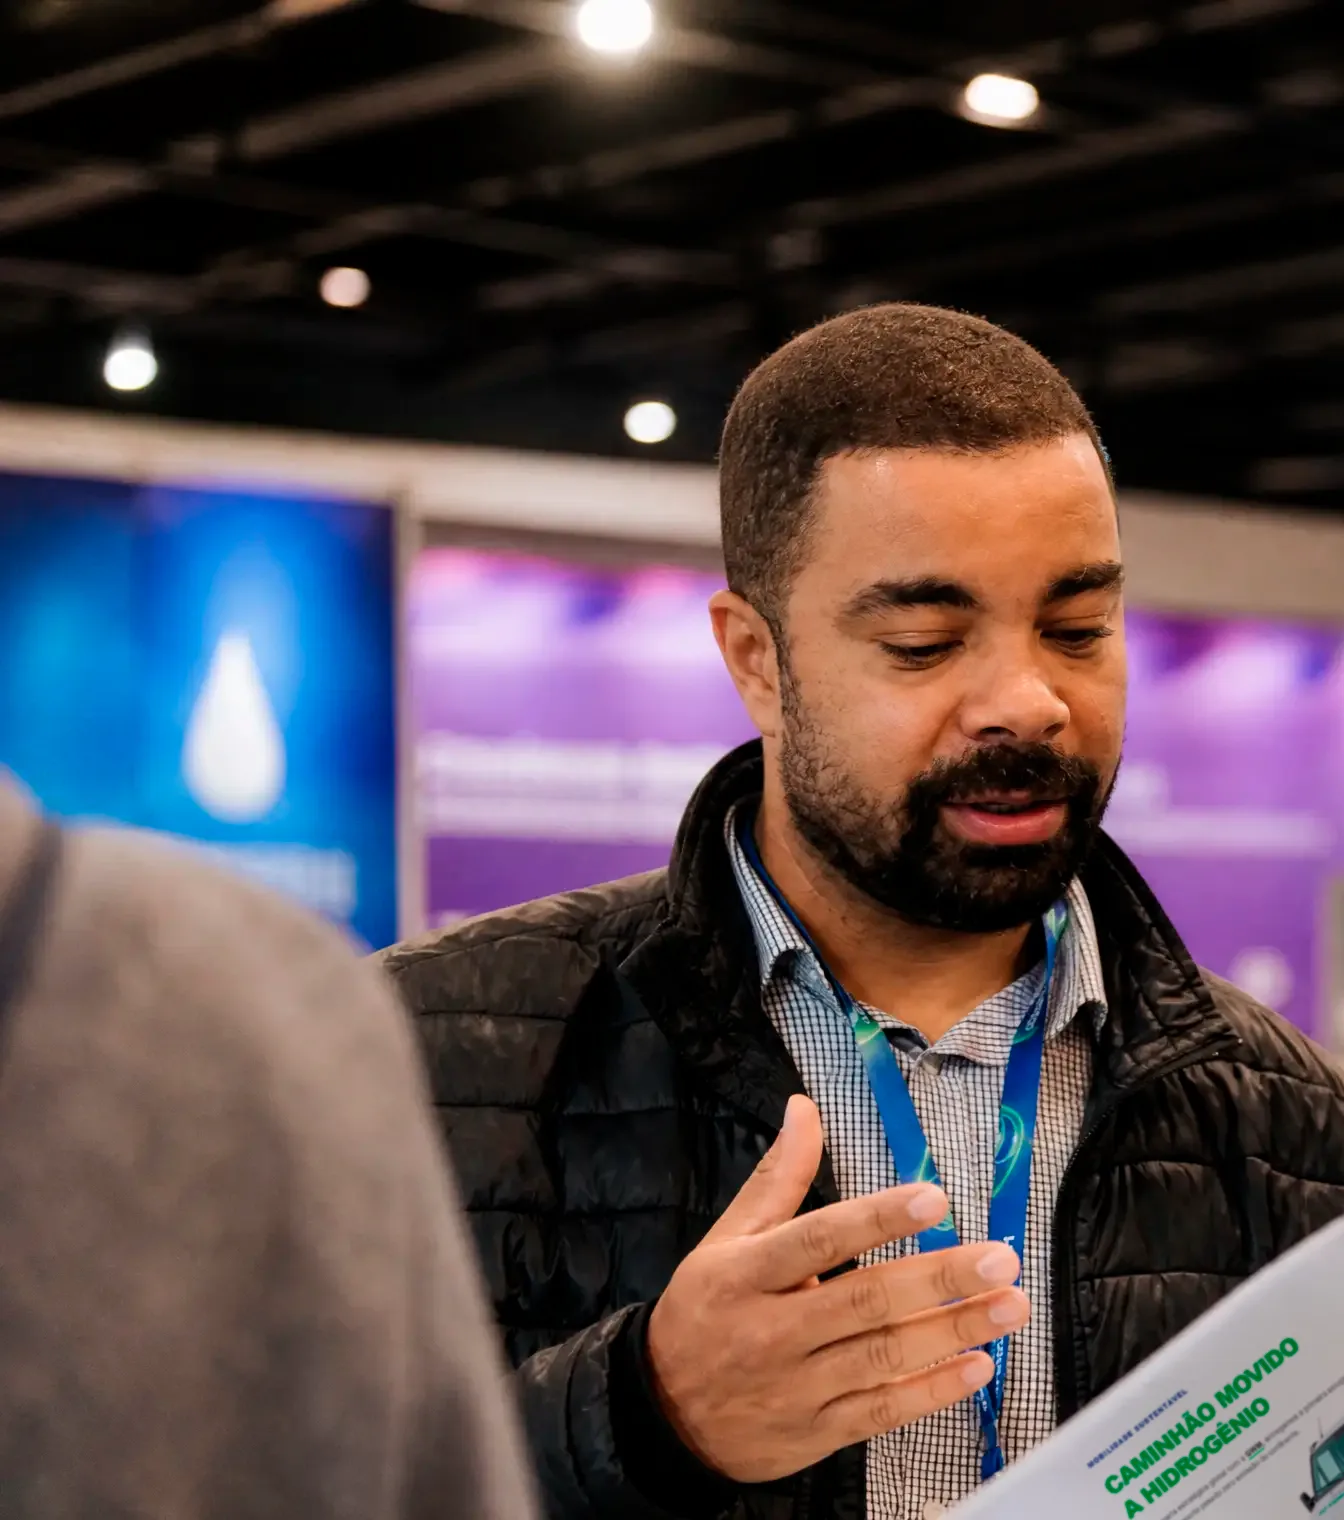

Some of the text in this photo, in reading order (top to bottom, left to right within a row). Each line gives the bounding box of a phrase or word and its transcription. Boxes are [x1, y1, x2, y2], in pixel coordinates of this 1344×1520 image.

[1087, 1430, 1134, 1469] MOBILIDADE
[1104, 1337, 1299, 1494] CAMINHÃO MOVIDO
[1124, 1498, 1145, 1519] A
[1140, 1397, 1270, 1504] HIDROGÊNIO
